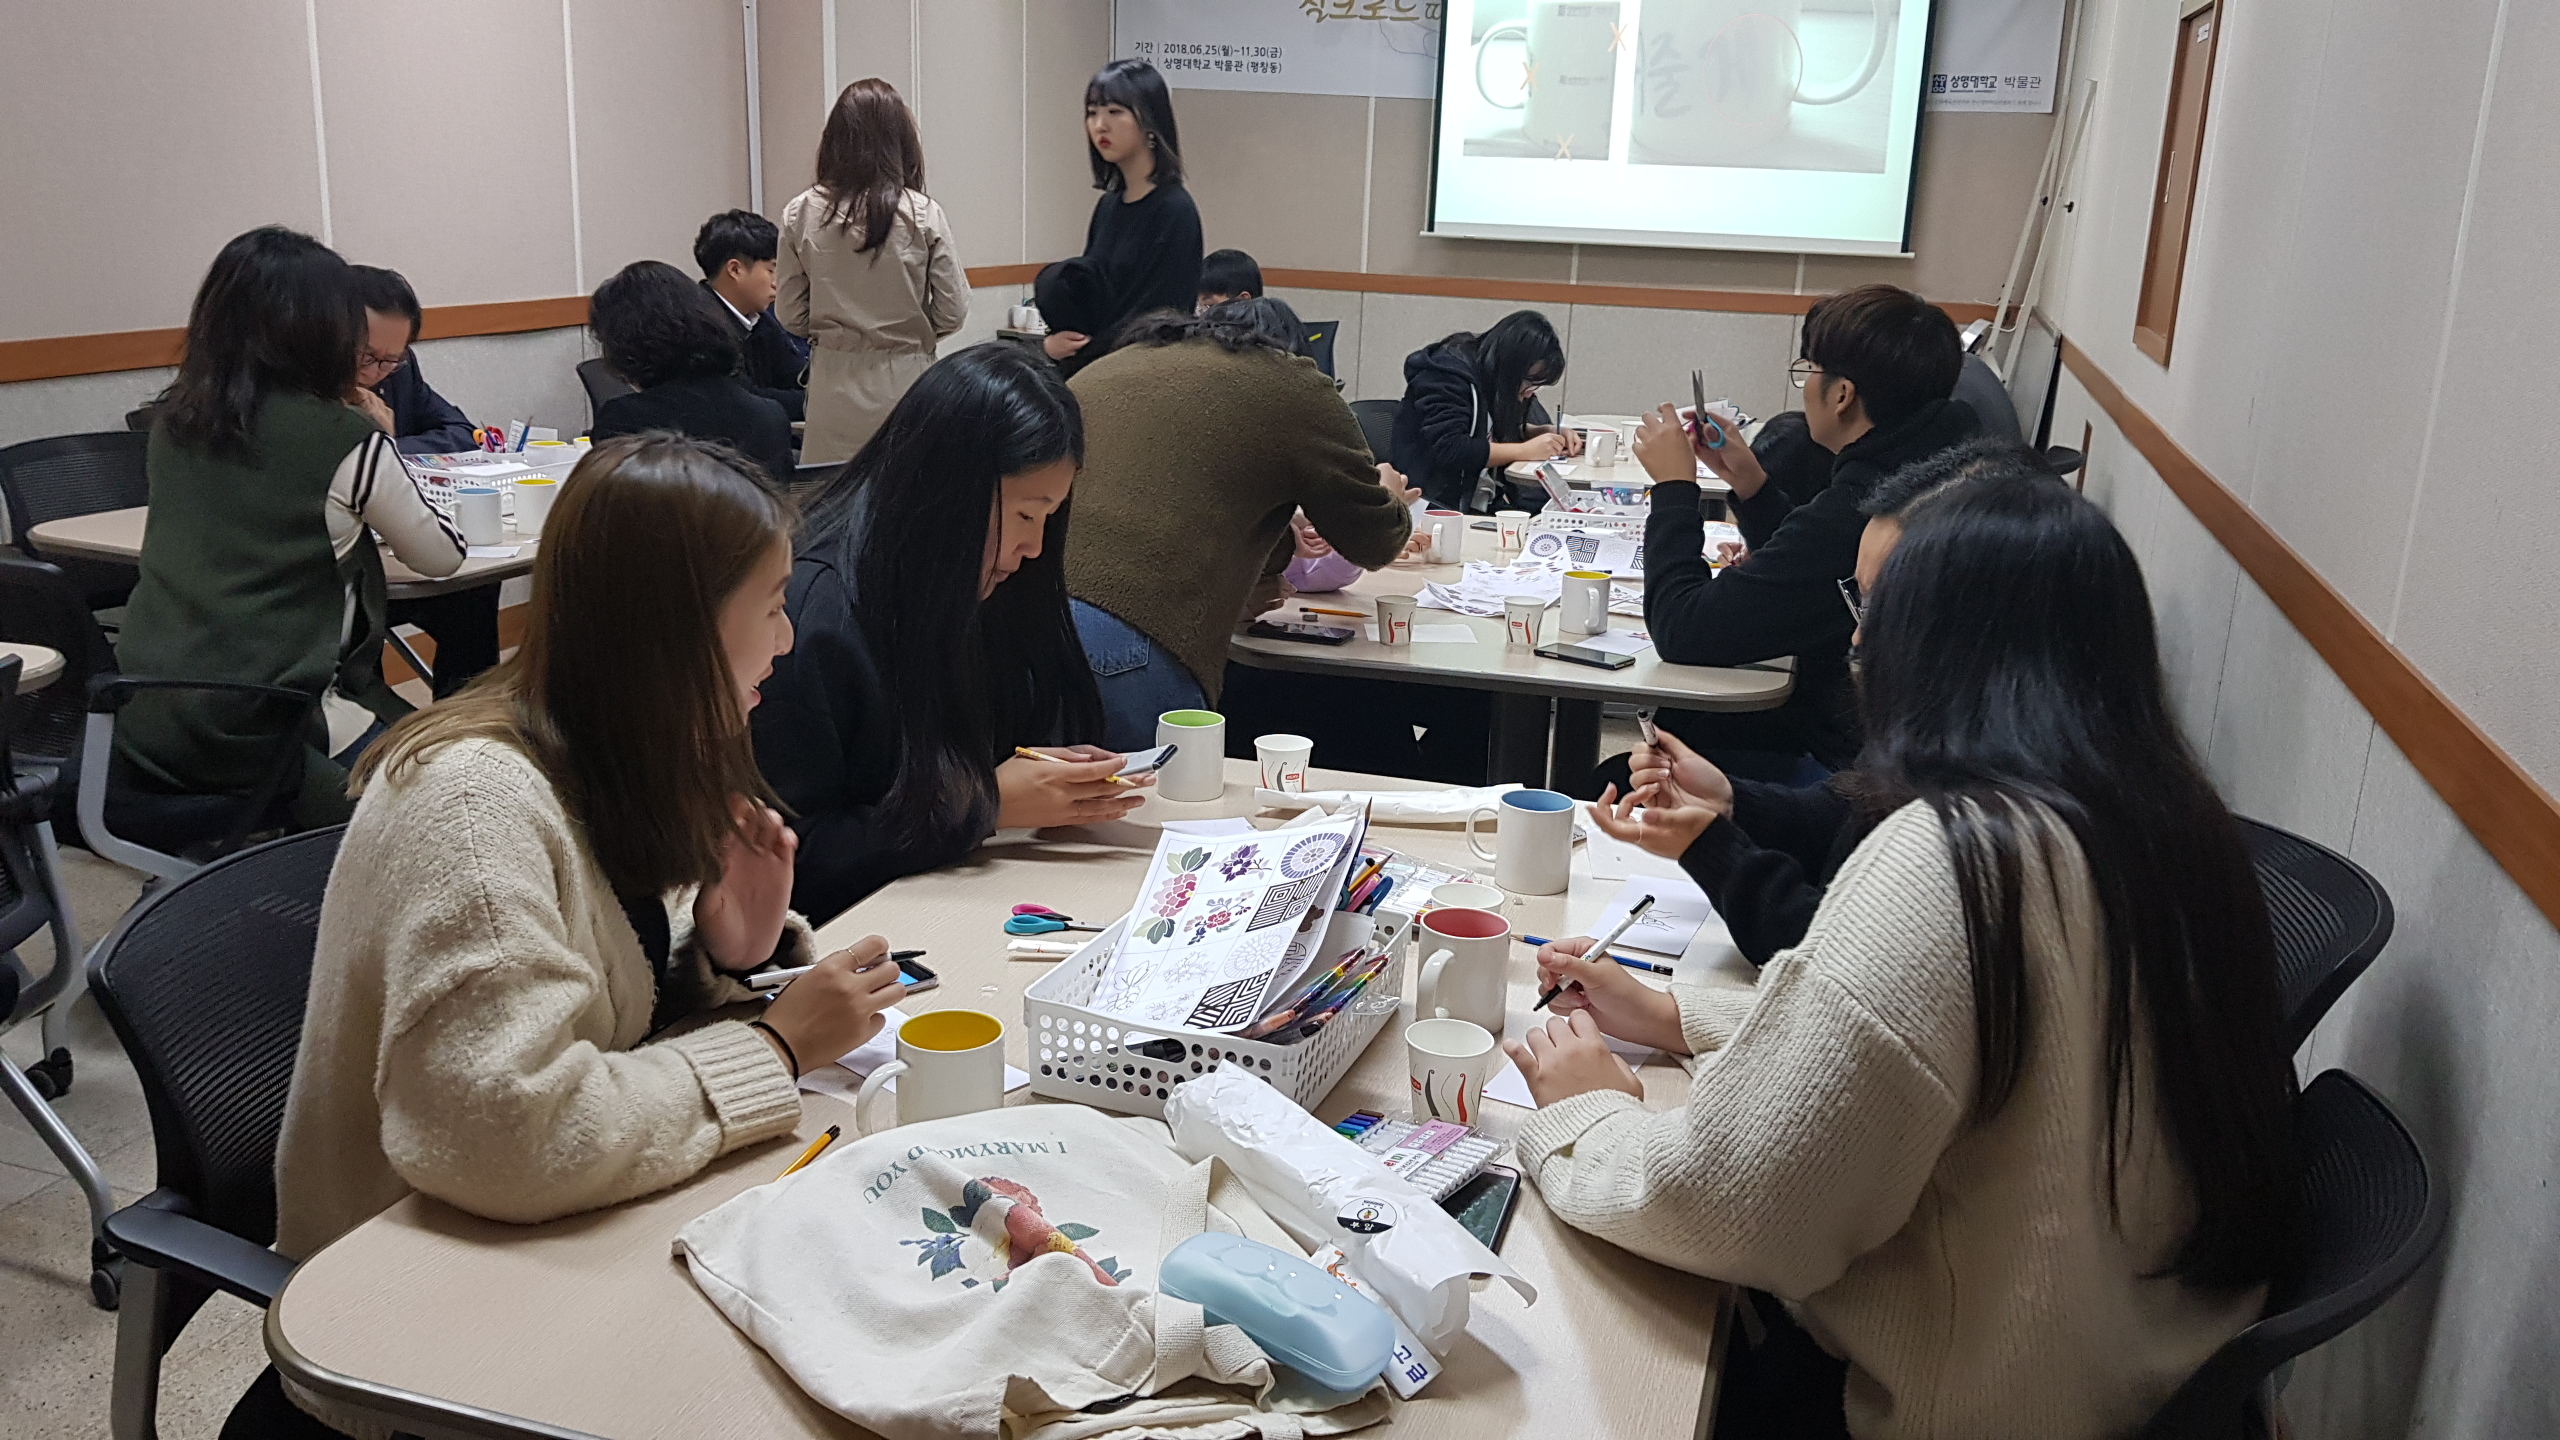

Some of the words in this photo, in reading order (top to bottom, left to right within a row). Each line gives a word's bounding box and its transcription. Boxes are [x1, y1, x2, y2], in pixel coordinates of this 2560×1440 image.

[1135, 41, 1153, 54] 기간
[1163, 58, 1211, 71] 상명대학교
[1214, 59, 1244, 72] 박물관
[1246, 61, 1282, 74] (평창동)
[1950, 75, 1998, 89] 상명대학교
[2004, 75, 2041, 89] 박물관
[907, 1141, 1051, 1160] MARYMOD
[1057, 1141, 1068, 1154] I
[863, 1161, 908, 1205] YOU
[1392, 1344, 1429, 1384] 고급
